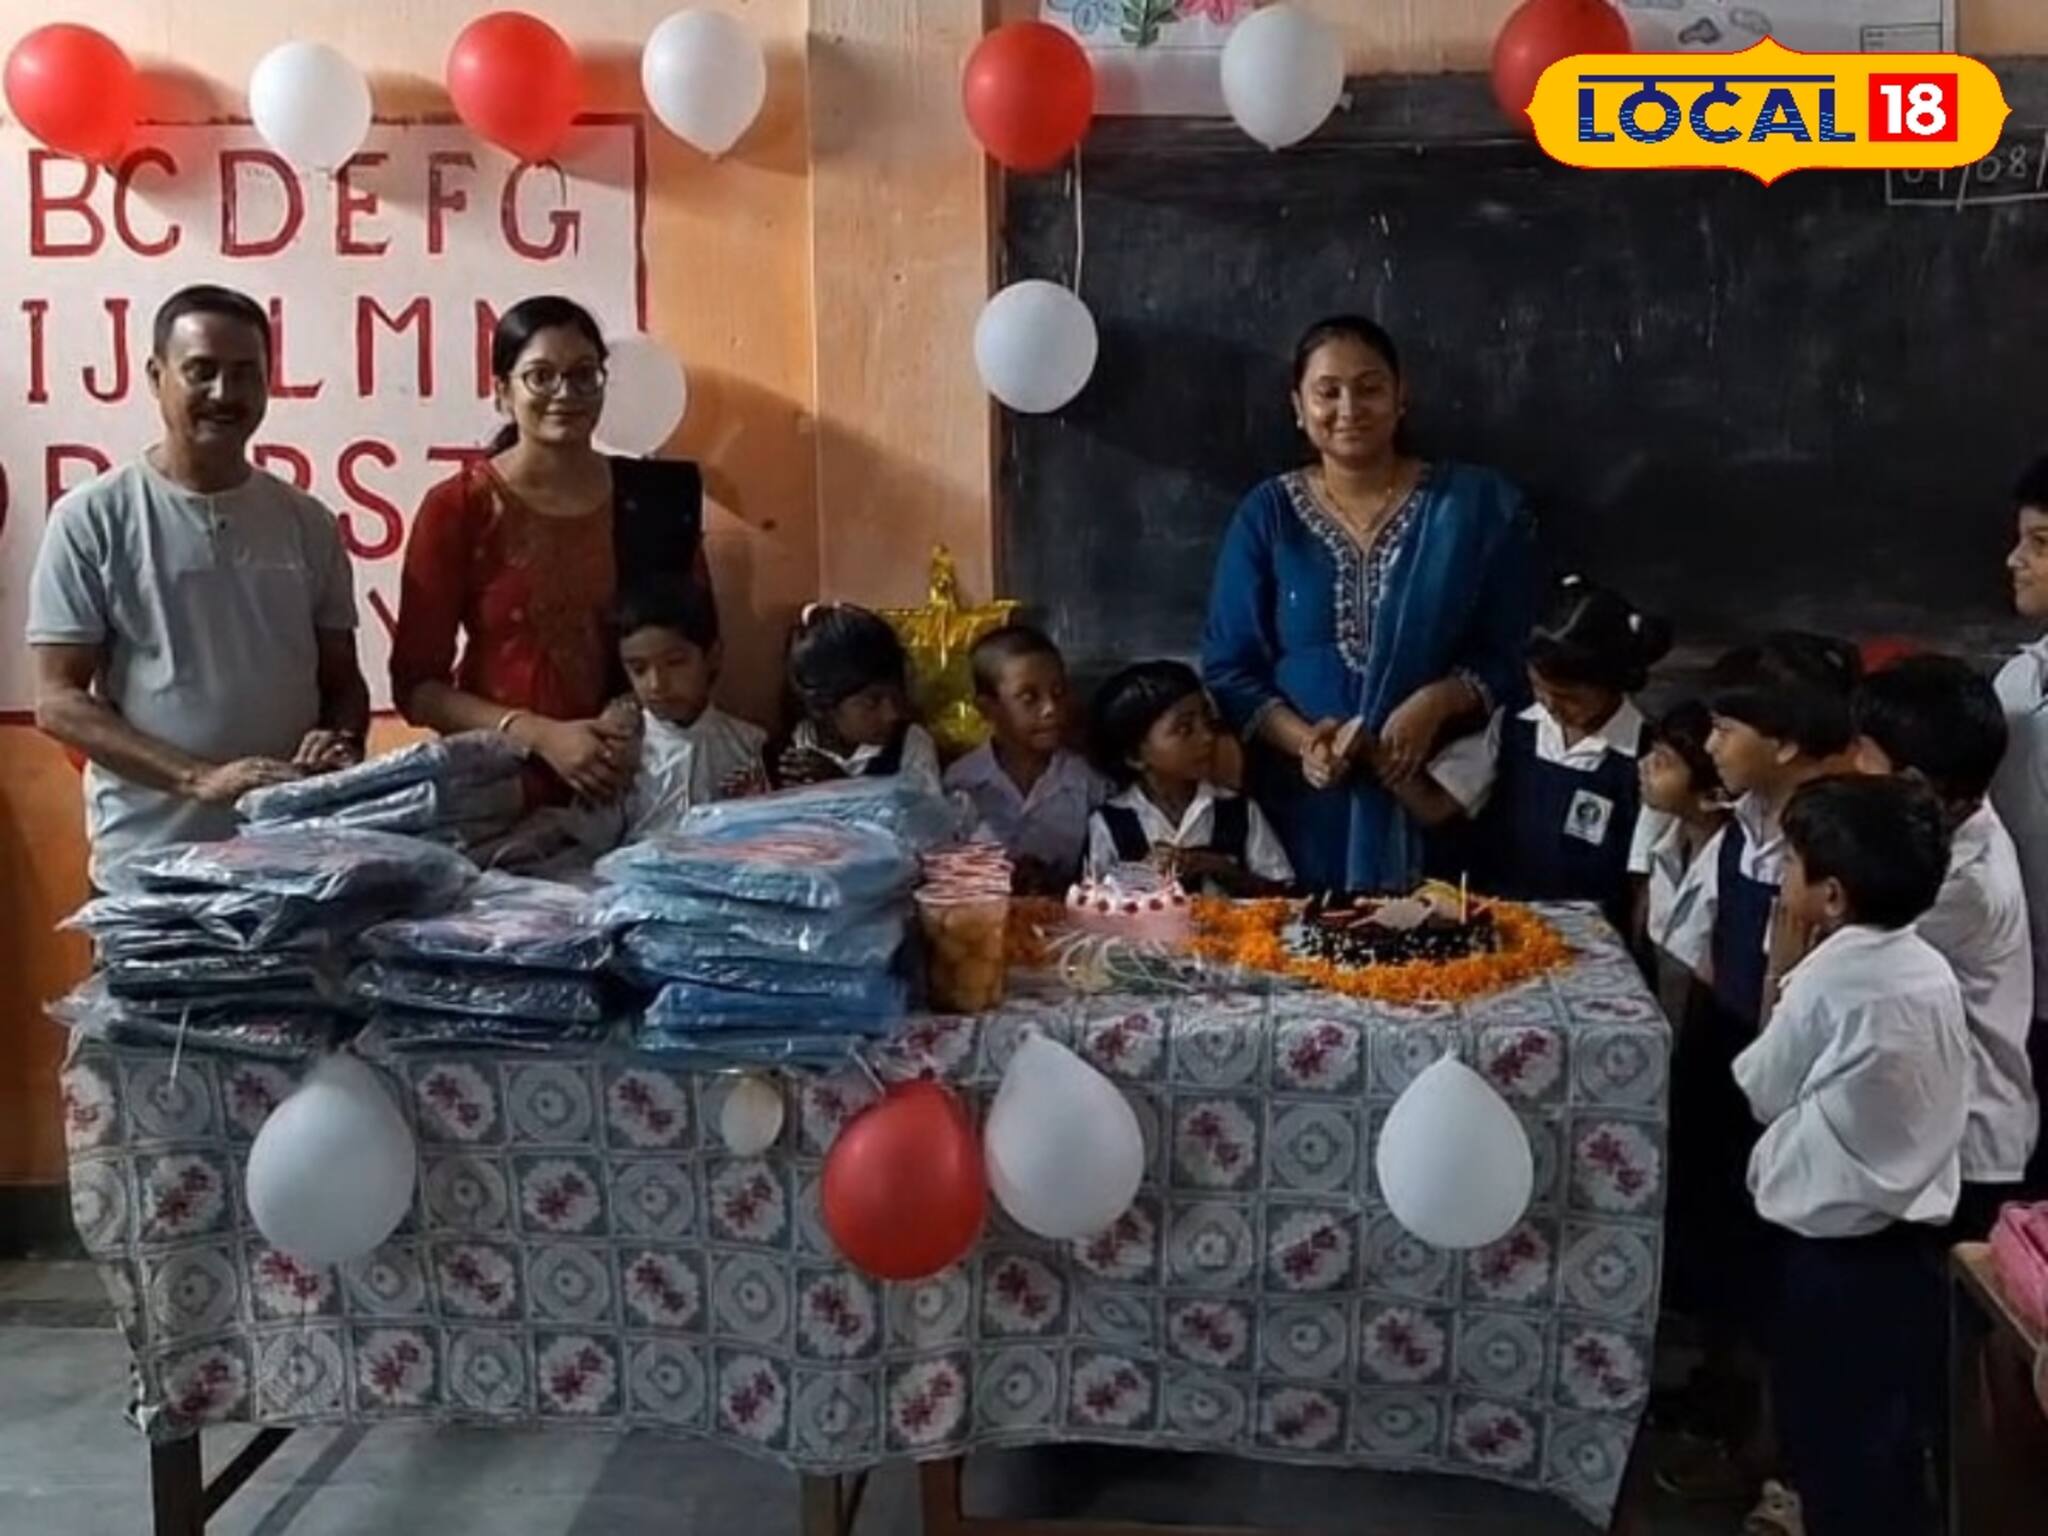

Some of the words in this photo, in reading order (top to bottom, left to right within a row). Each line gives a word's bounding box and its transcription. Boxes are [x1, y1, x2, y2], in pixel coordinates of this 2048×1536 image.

[220, 150, 304, 257] D
[336, 152, 391, 255] E
[427, 152, 476, 254] F
[502, 159, 582, 259] G
[356, 296, 431, 398] M
